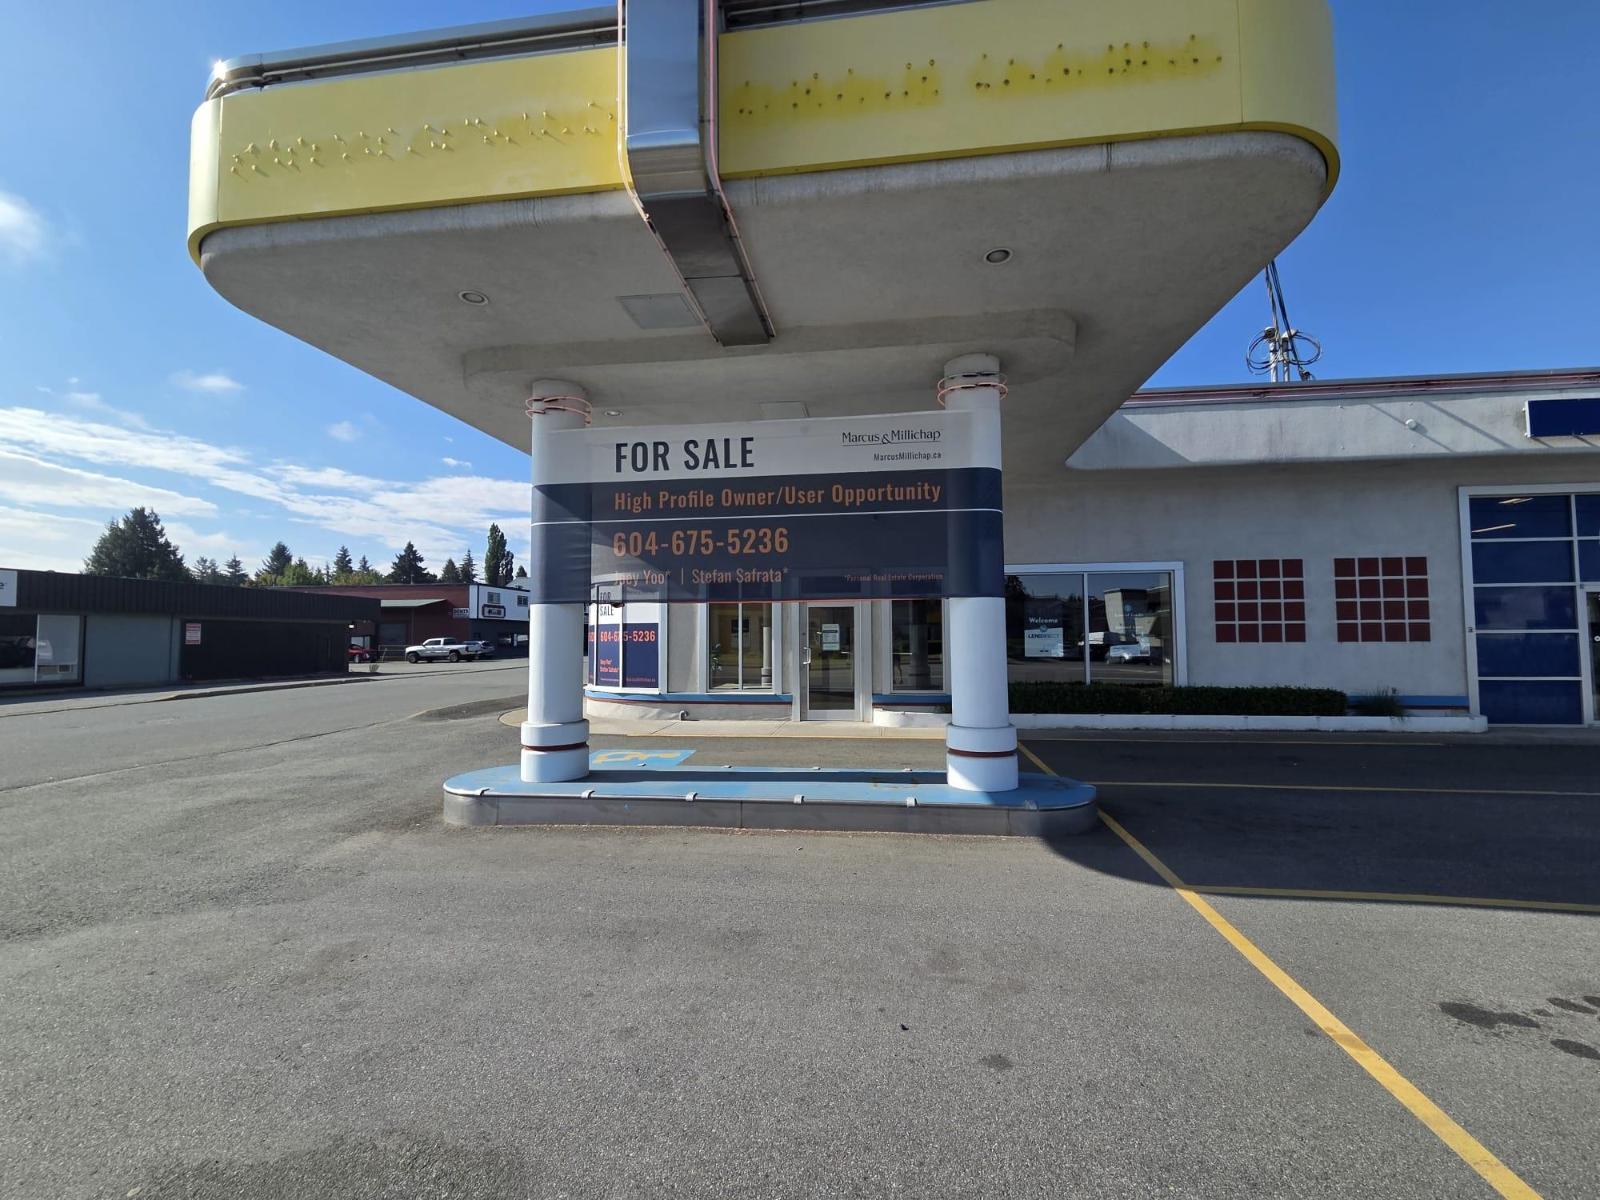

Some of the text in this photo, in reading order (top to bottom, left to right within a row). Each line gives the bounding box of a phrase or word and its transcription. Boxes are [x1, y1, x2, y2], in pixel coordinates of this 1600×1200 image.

[841, 431, 880, 443] Marcus
[891, 429, 941, 441] Millichap
[615, 437, 755, 473] FOR SALE
[873, 451, 942, 461] MarcusMillichap.ca
[614, 481, 941, 513] High Profile Owner/User Opportunity
[613, 527, 789, 557] 604-675-5236
[691, 568, 732, 584] Stefan
[600, 591, 612, 603] FOR
[600, 605, 614, 616] SALE
[1029, 616, 1059, 624] Welcome
